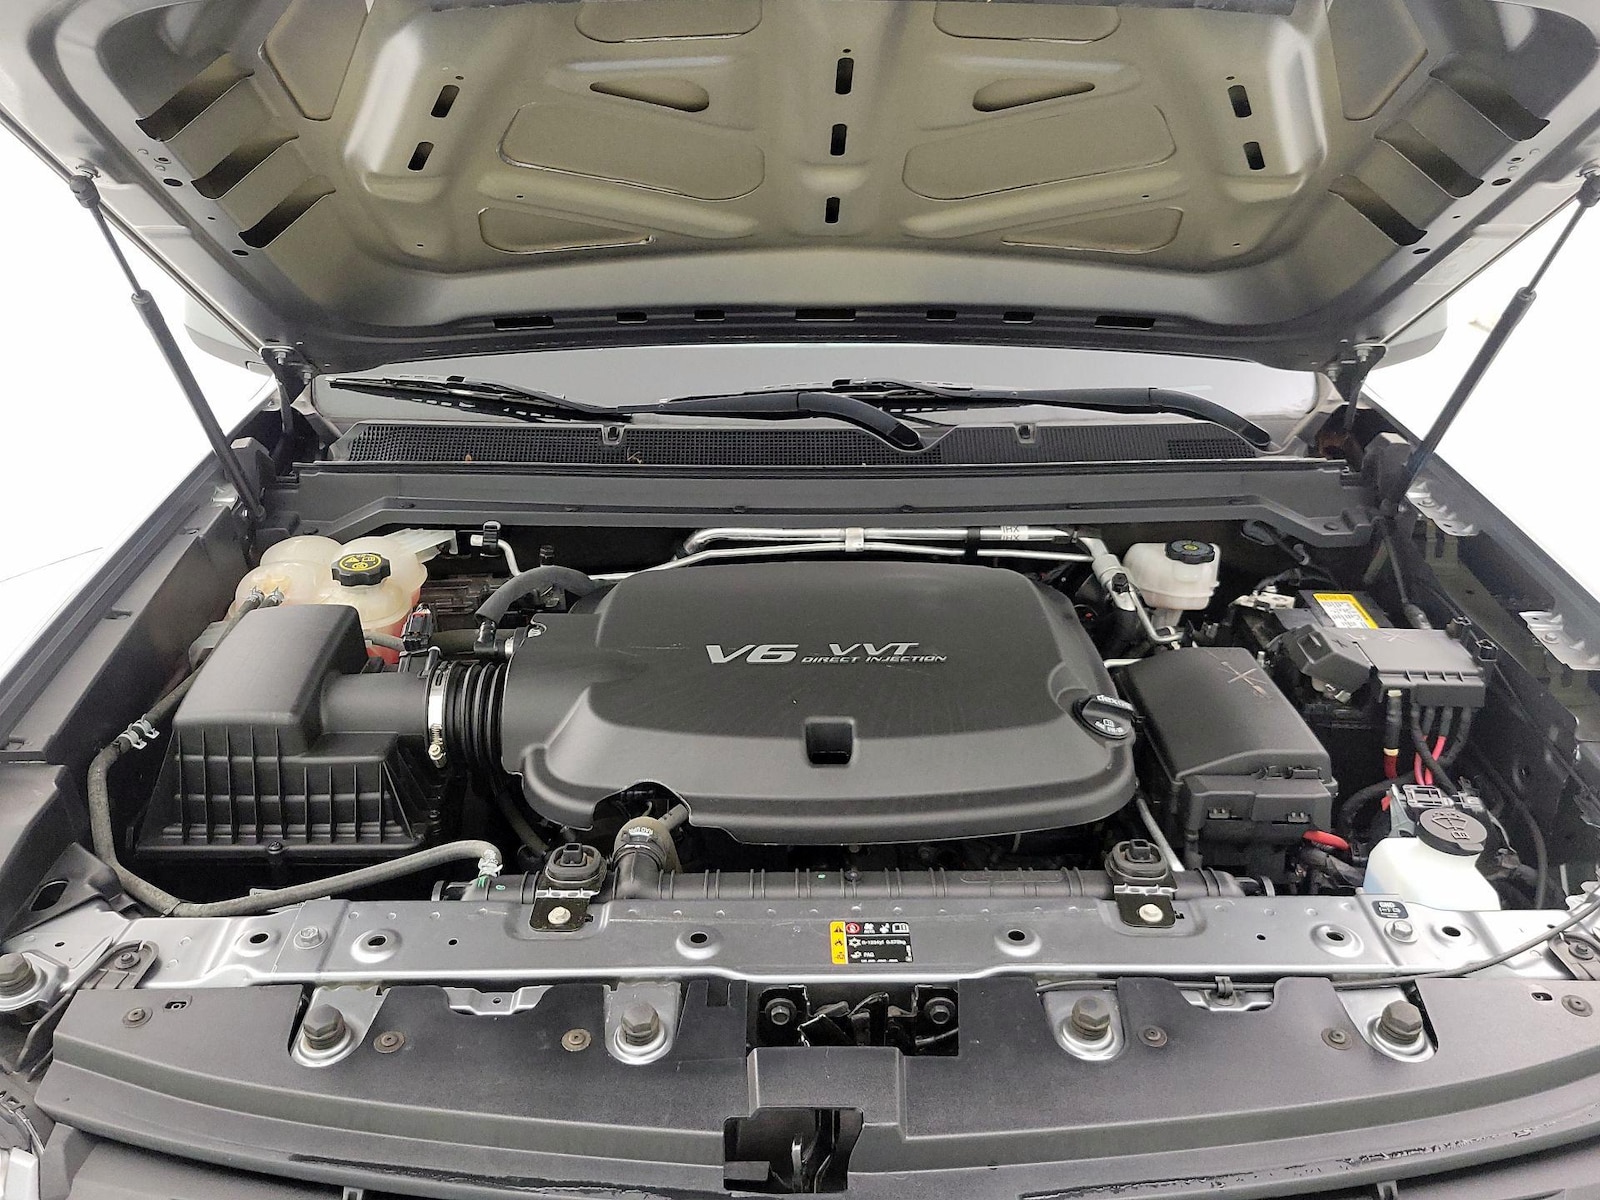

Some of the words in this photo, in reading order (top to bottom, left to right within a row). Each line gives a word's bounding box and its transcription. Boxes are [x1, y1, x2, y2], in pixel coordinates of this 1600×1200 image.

[705, 643, 799, 664] V6
[829, 642, 920, 656] VVT
[801, 655, 861, 664] DIRECT
[865, 655, 948, 663] INJECTION
